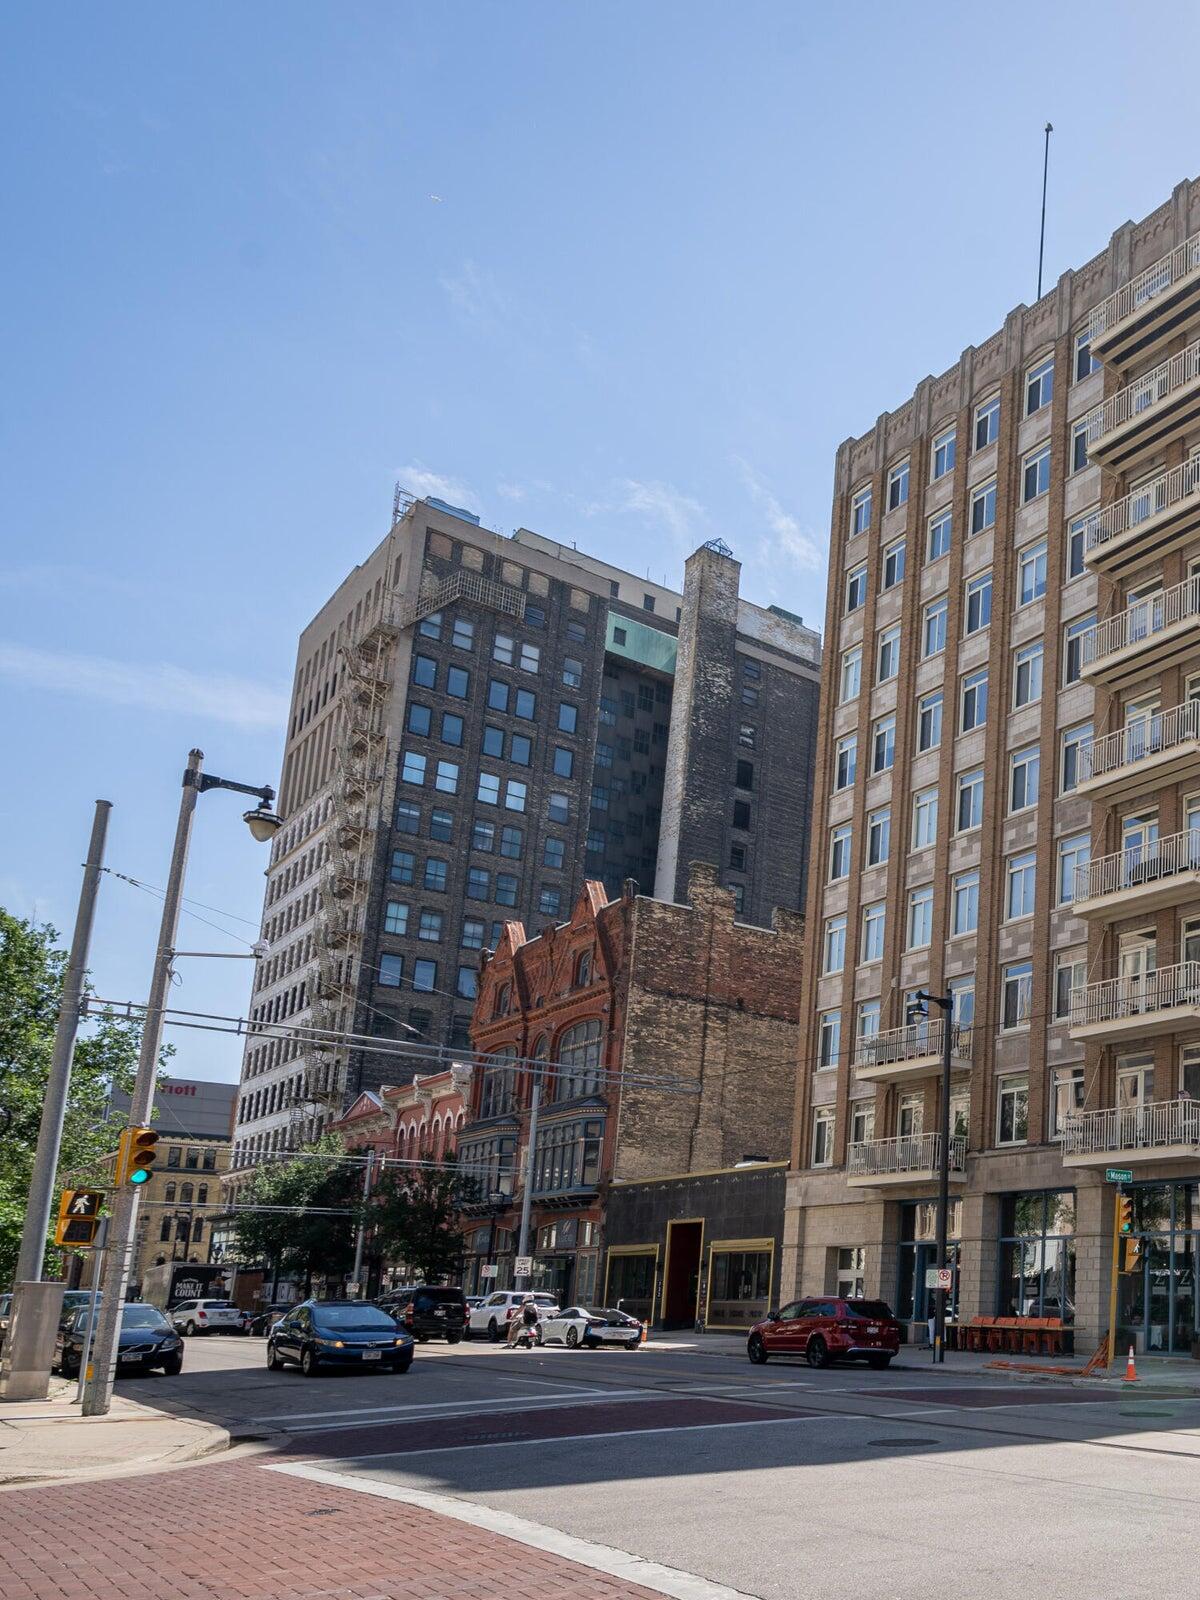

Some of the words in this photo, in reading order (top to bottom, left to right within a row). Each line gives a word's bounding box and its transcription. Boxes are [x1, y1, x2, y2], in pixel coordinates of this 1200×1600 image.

[161, 1084, 197, 1096] riott
[1110, 1171, 1127, 1180] Mason
[516, 1267, 529, 1275] 25
[175, 1282, 194, 1290] MAKE
[195, 1282, 204, 1290] IT
[174, 1289, 203, 1297] COUNT
